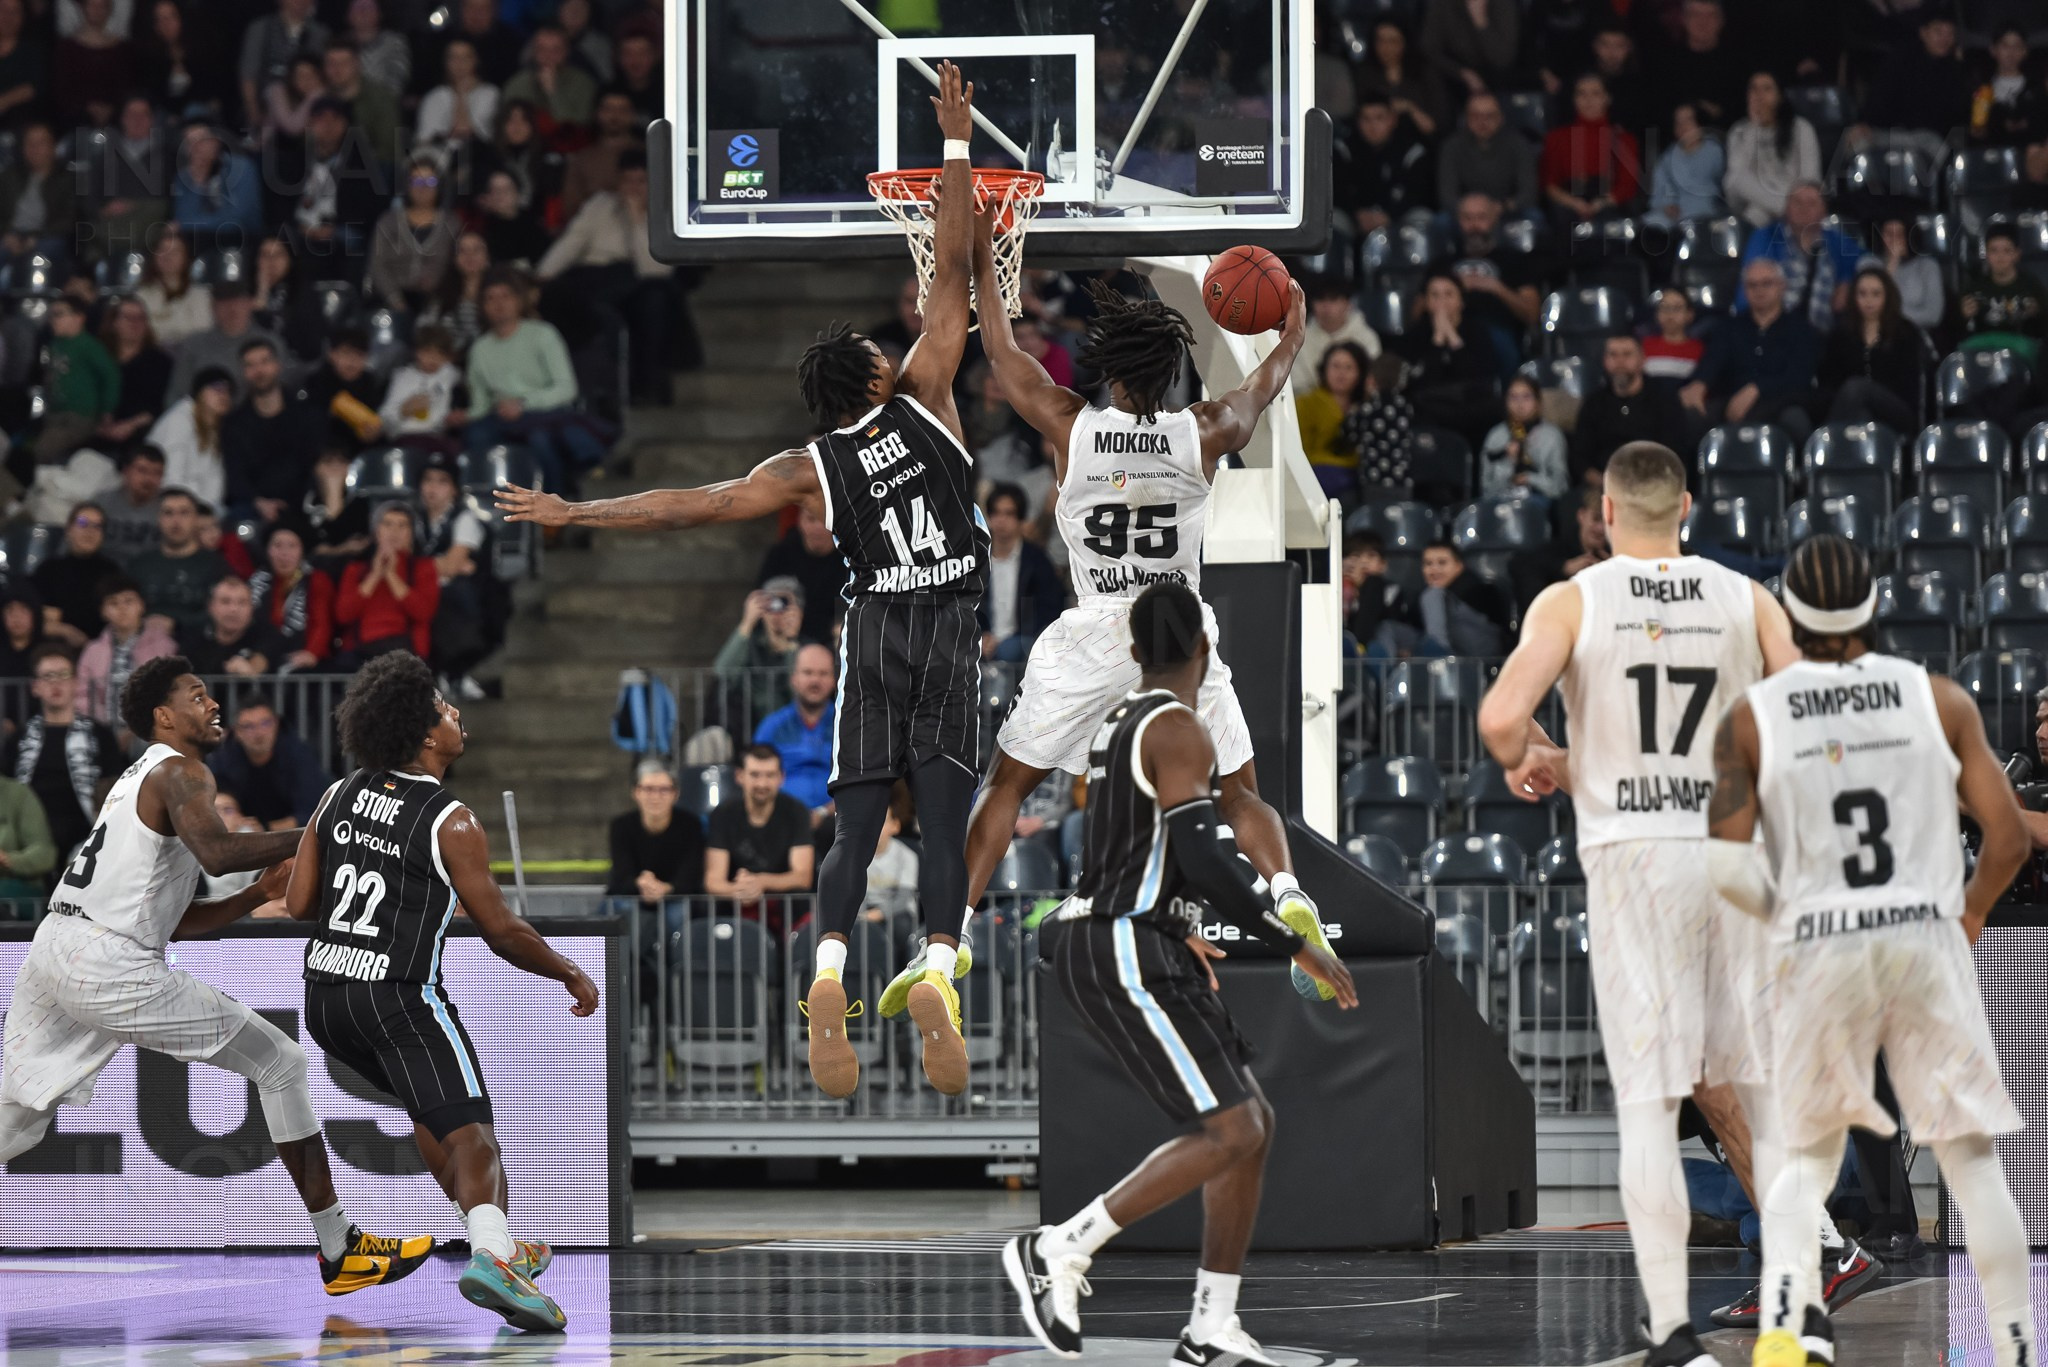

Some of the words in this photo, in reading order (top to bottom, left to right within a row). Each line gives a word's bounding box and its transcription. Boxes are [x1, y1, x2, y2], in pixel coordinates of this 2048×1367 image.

[1216, 150, 1264, 159] oneteam
[720, 188, 768, 200] EuroCup
[724, 172, 763, 185] BKT
[1094, 431, 1172, 455] MOKOKA
[887, 461, 926, 488] VEOLIA
[880, 495, 948, 566] 14
[1083, 503, 1179, 559] 95
[1625, 663, 1718, 758] 17
[1788, 681, 1903, 720] SIMPSON
[352, 788, 404, 826] STOVE
[354, 830, 401, 859] VEOLIA
[1832, 787, 1895, 889] 3
[328, 863, 387, 938] 22
[307, 938, 391, 982] HAMBURG
